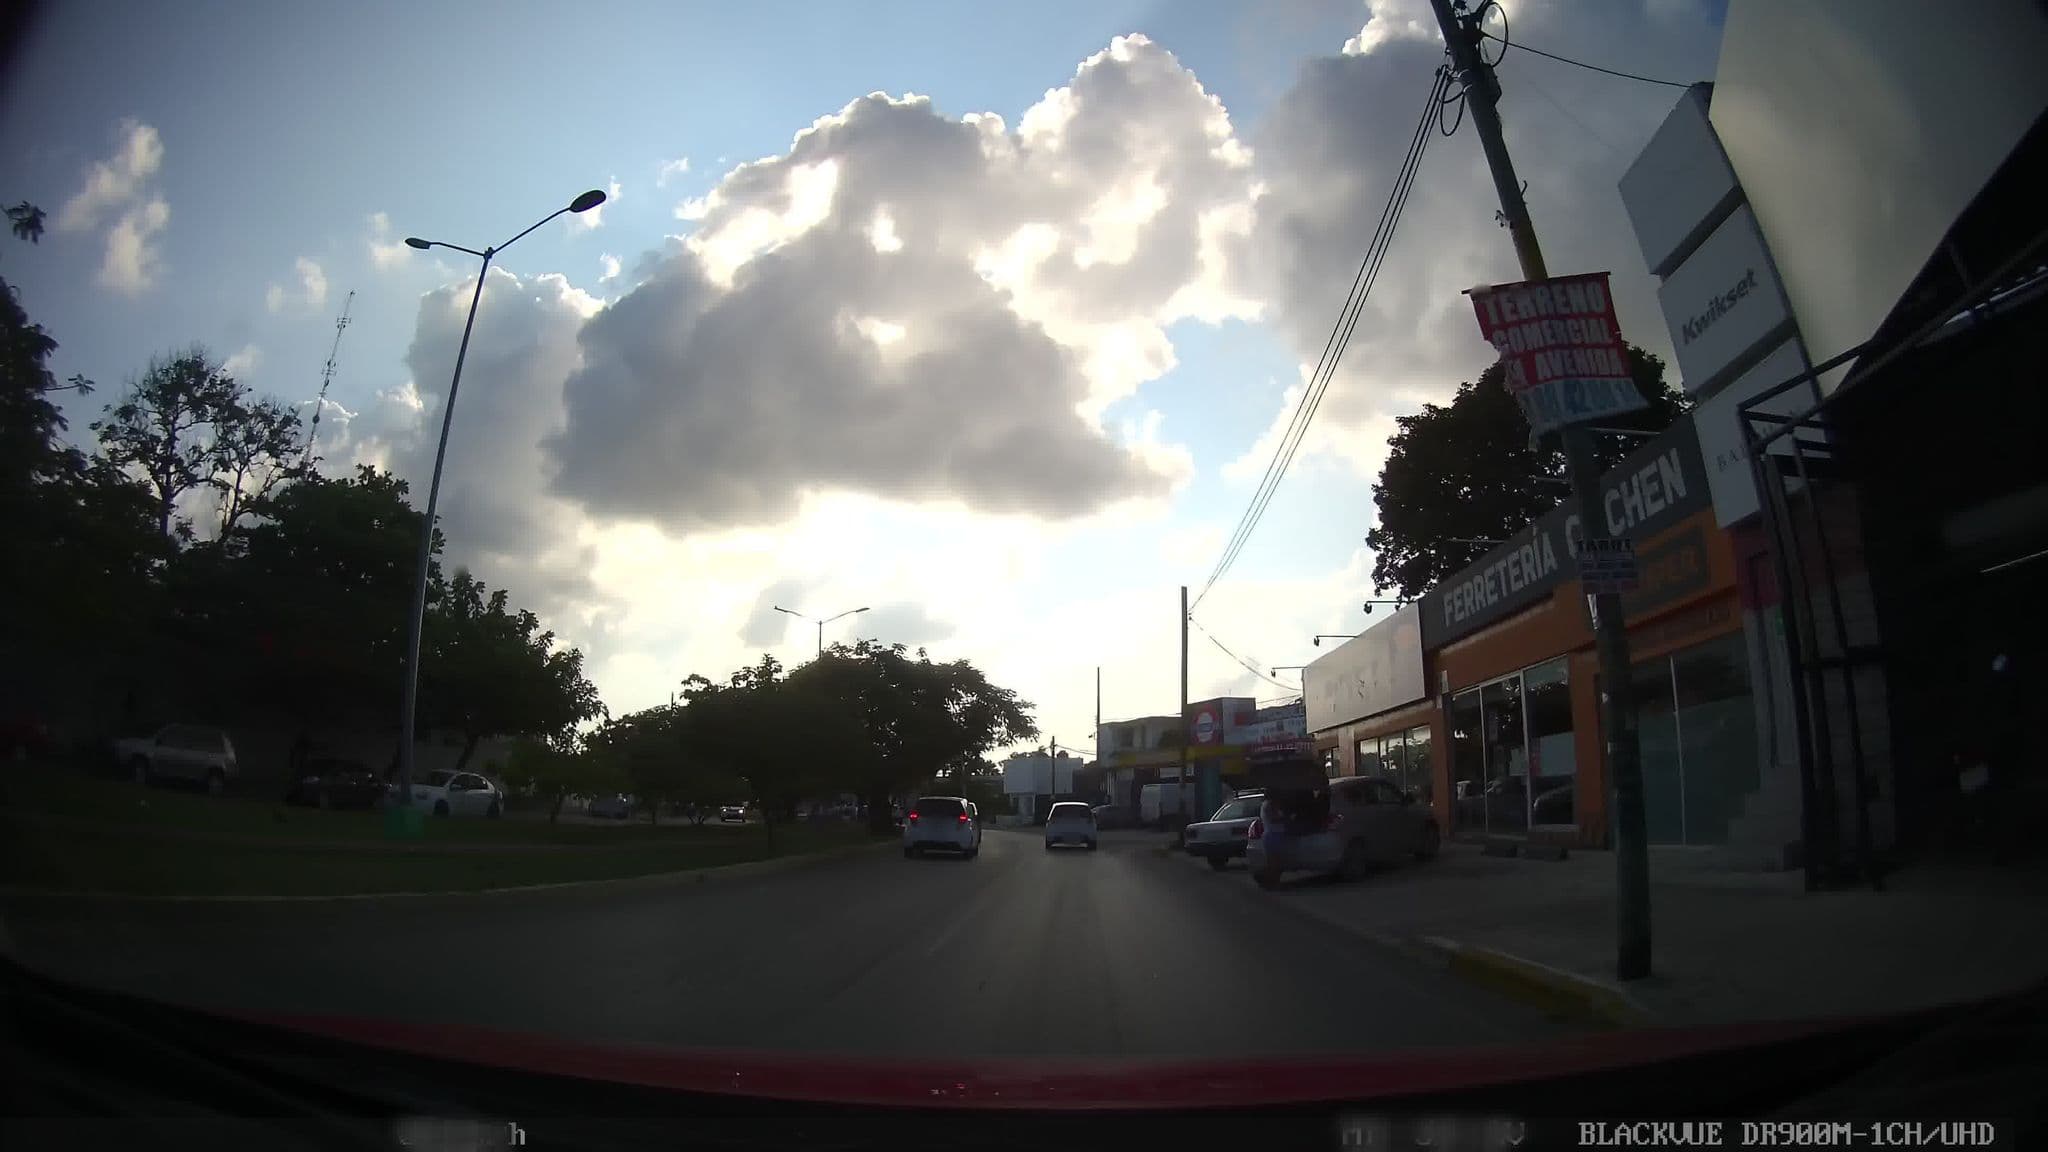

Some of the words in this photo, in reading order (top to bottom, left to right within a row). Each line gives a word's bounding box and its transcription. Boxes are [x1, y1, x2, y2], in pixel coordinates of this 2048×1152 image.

[1481, 280, 1607, 325] TERRENO
[1681, 267, 1758, 346] Kwikset
[1491, 317, 1614, 354] COMERCIAL
[1534, 348, 1625, 380] AVENIDA
[1443, 527, 1558, 627] FERRETERÍA
